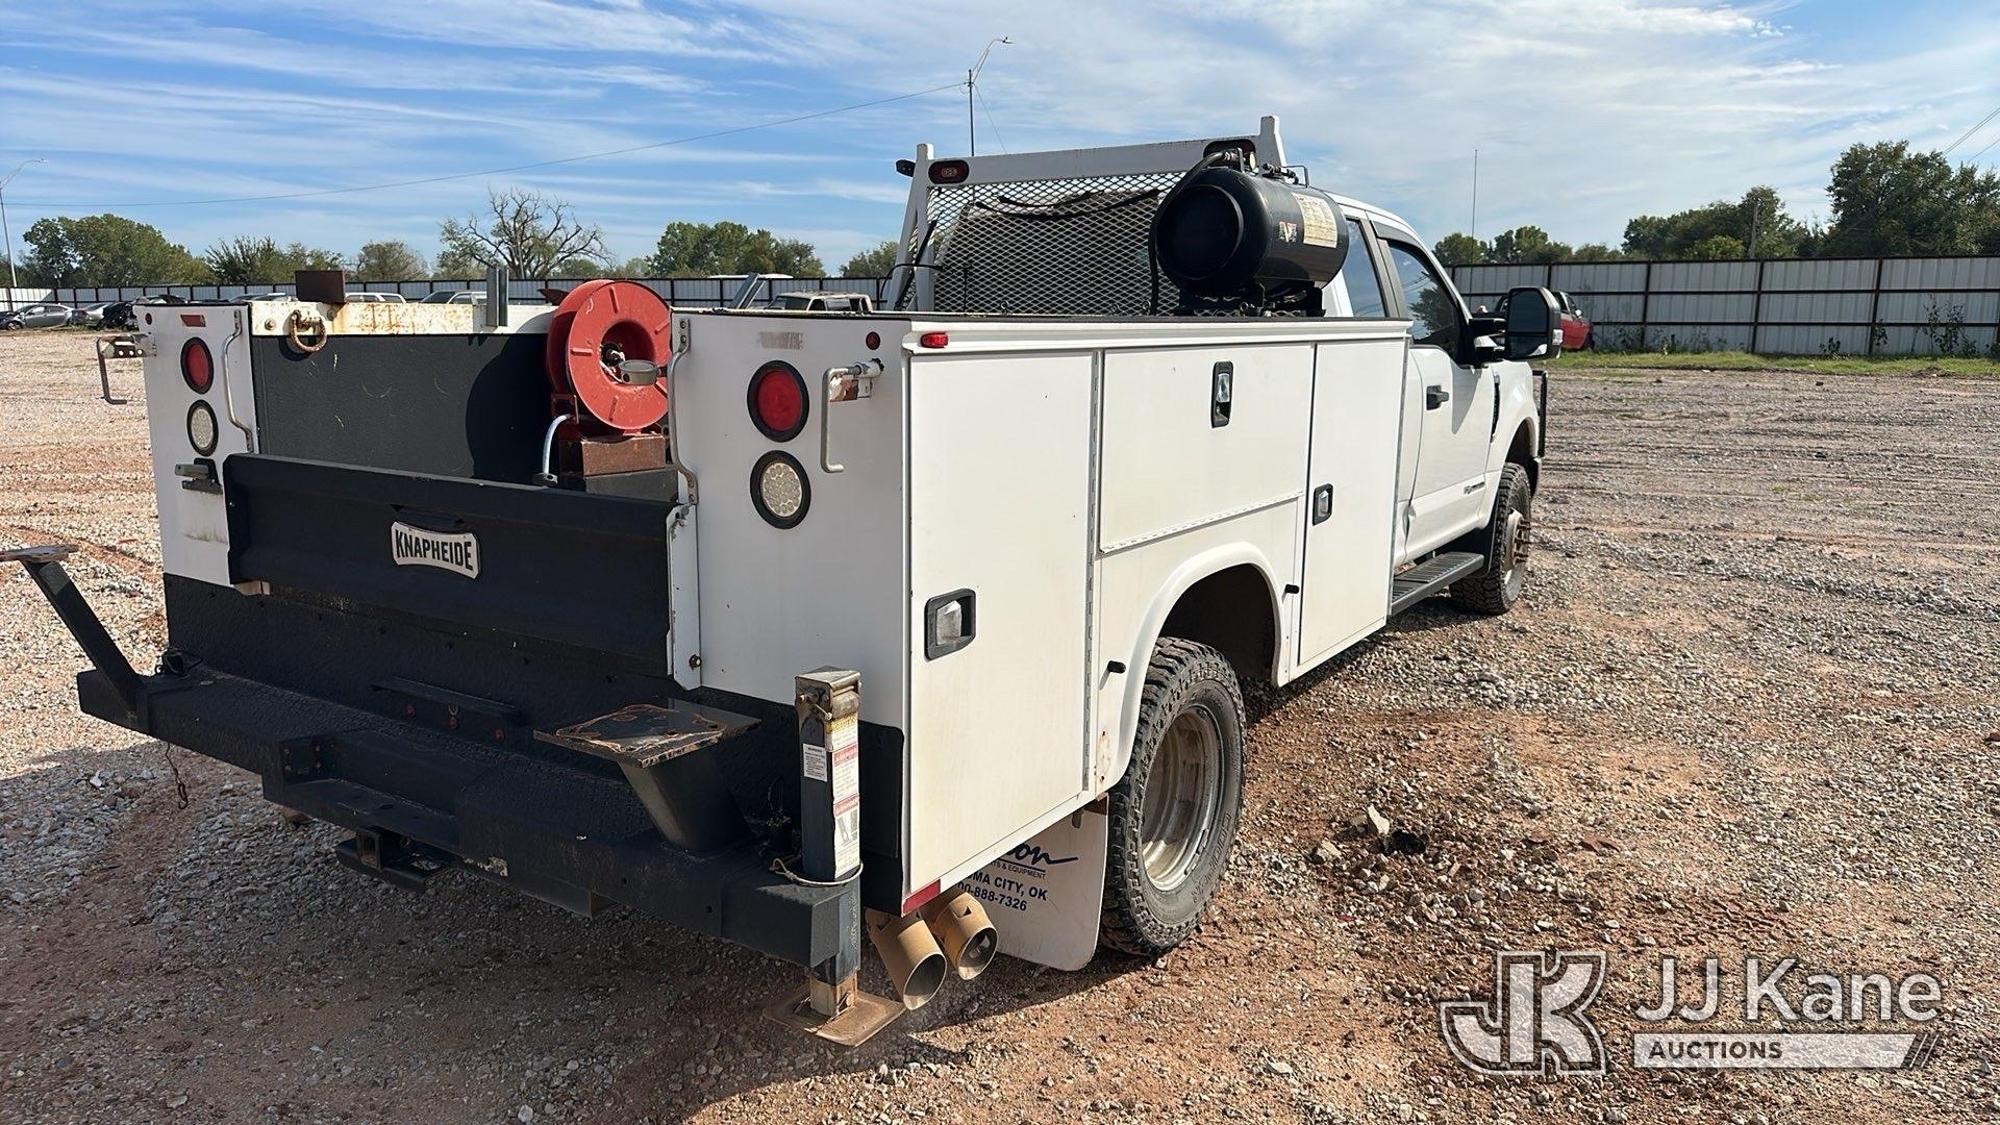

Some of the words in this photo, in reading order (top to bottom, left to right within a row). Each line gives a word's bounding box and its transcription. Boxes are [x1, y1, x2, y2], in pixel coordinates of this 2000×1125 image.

[395, 529, 474, 571] KNAPHEIDE
[1008, 864, 1047, 880] EQUIPMENT
[994, 877, 1025, 897] CITY,
[1028, 886, 1049, 901] OK
